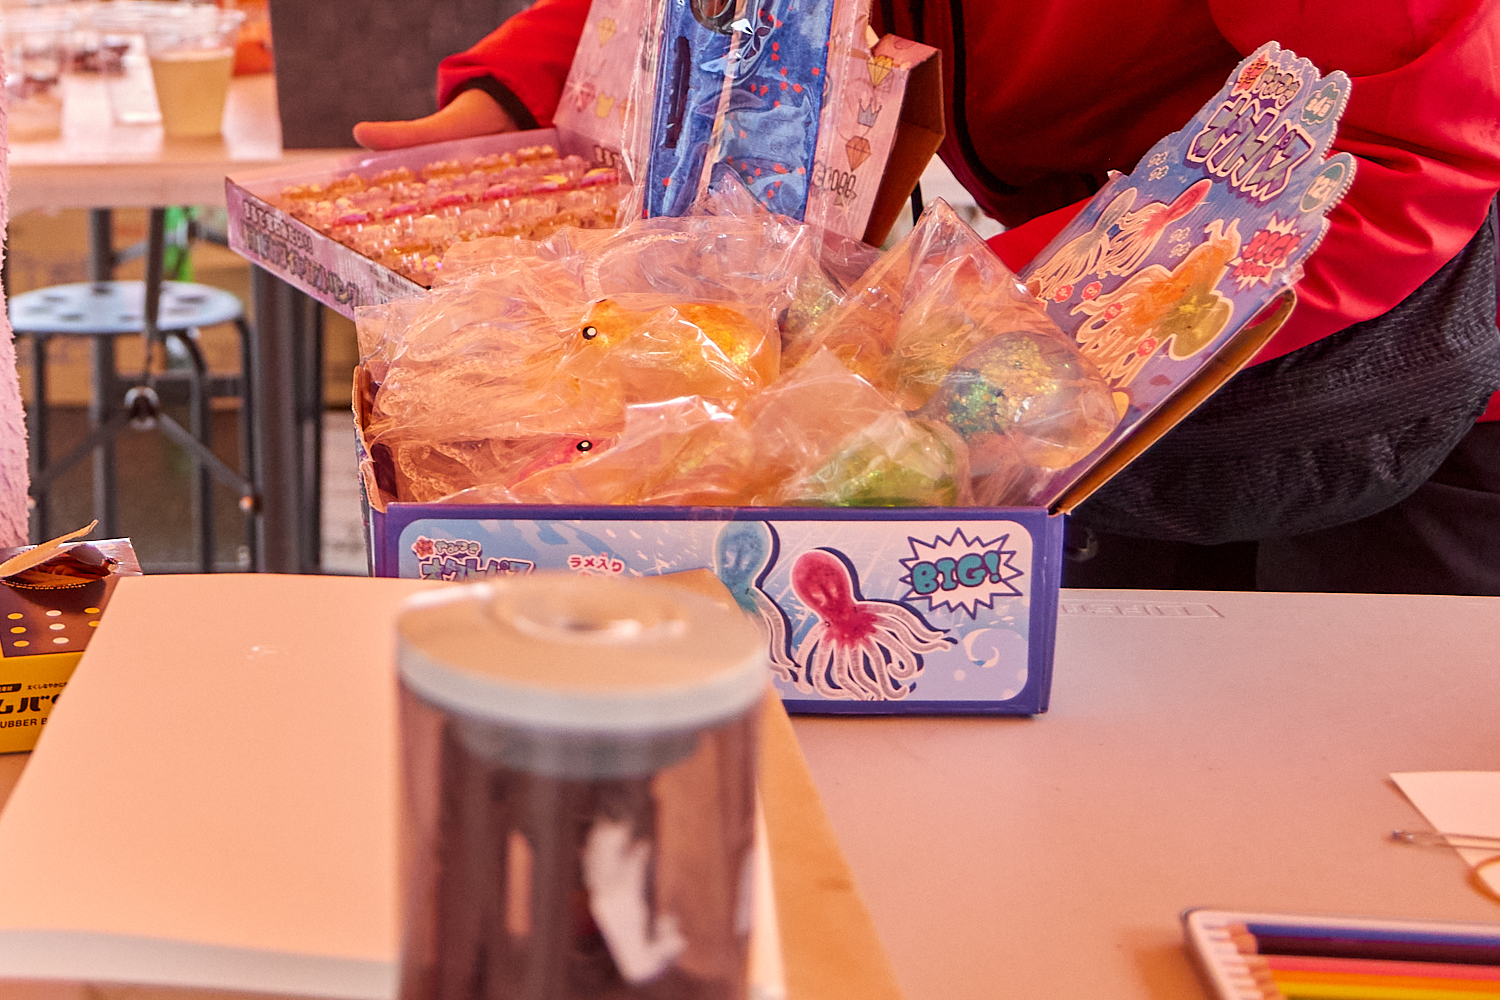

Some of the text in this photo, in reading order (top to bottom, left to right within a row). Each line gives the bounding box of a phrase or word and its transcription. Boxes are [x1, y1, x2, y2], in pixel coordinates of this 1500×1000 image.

[1242, 230, 1301, 267] BIG!
[569, 555, 624, 573] ラメ入り
[911, 550, 1001, 596] BIG!
